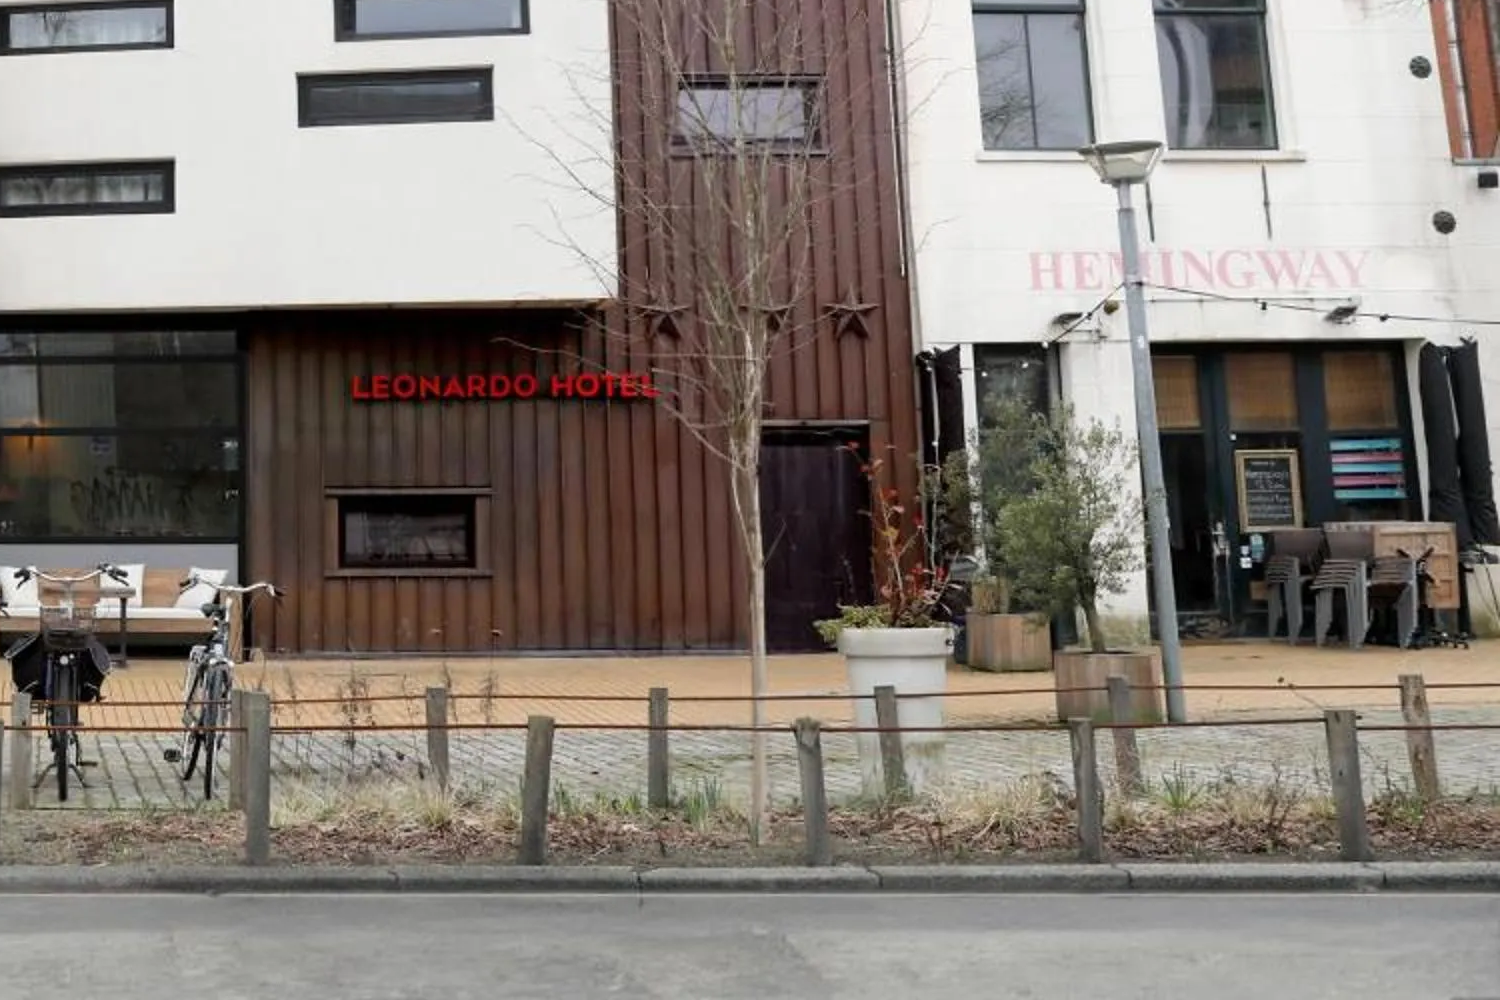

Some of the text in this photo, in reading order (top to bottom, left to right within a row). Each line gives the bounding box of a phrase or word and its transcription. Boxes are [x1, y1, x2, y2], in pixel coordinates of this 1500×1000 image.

[1028, 249, 1371, 291] HEMINGWAY
[352, 372, 661, 399] LEONARDO HOTEL
